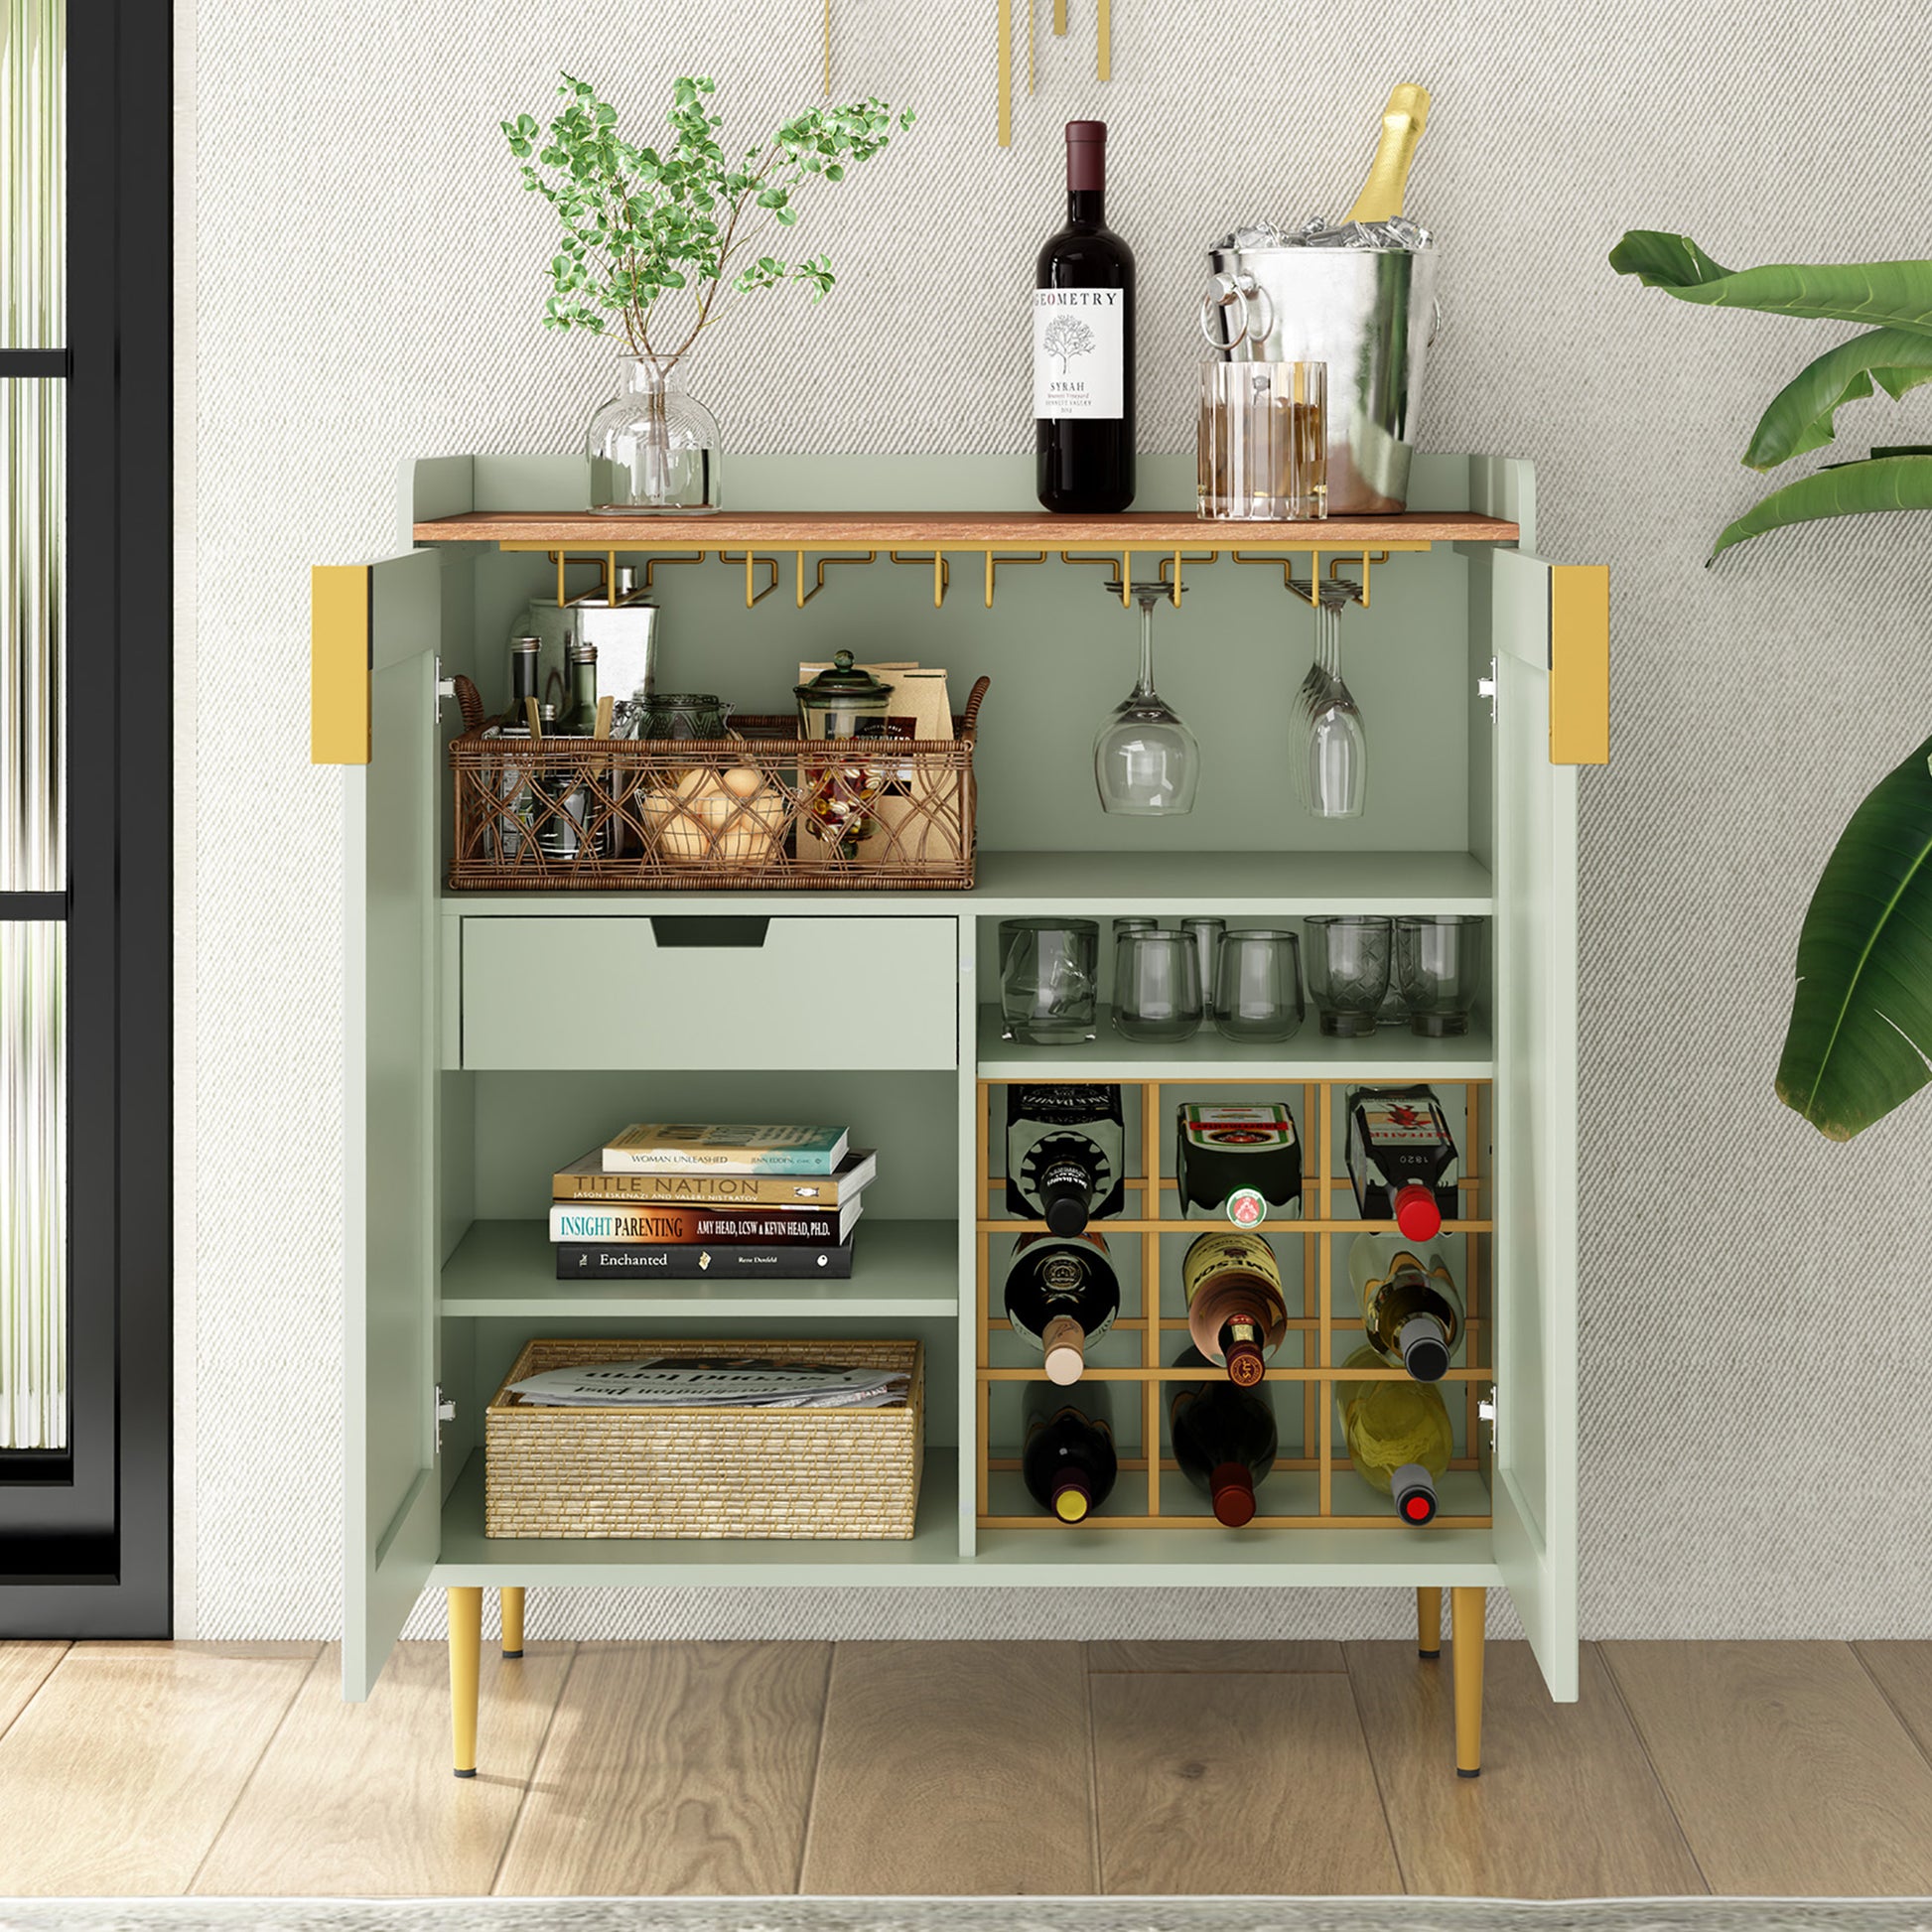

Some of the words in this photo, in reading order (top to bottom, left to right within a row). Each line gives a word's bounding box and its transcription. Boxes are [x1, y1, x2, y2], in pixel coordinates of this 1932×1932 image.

[1049, 382, 1084, 391] SYRAH
[1399, 1155, 1429, 1164] 1820
[573, 1175, 642, 1192] TITLE
[654, 1177, 759, 1194] NATION
[560, 1216, 613, 1237] INSIGHT
[615, 1217, 683, 1238] PARENTING
[696, 1220, 715, 1235] AMY
[715, 1220, 739, 1237] HEAD,
[739, 1220, 758, 1235] LCSW
[764, 1221, 786, 1235] KEVIN
[787, 1221, 810, 1239] HEAD,
[810, 1221, 831, 1236] PH.D.
[600, 1253, 668, 1266] Enchanted
